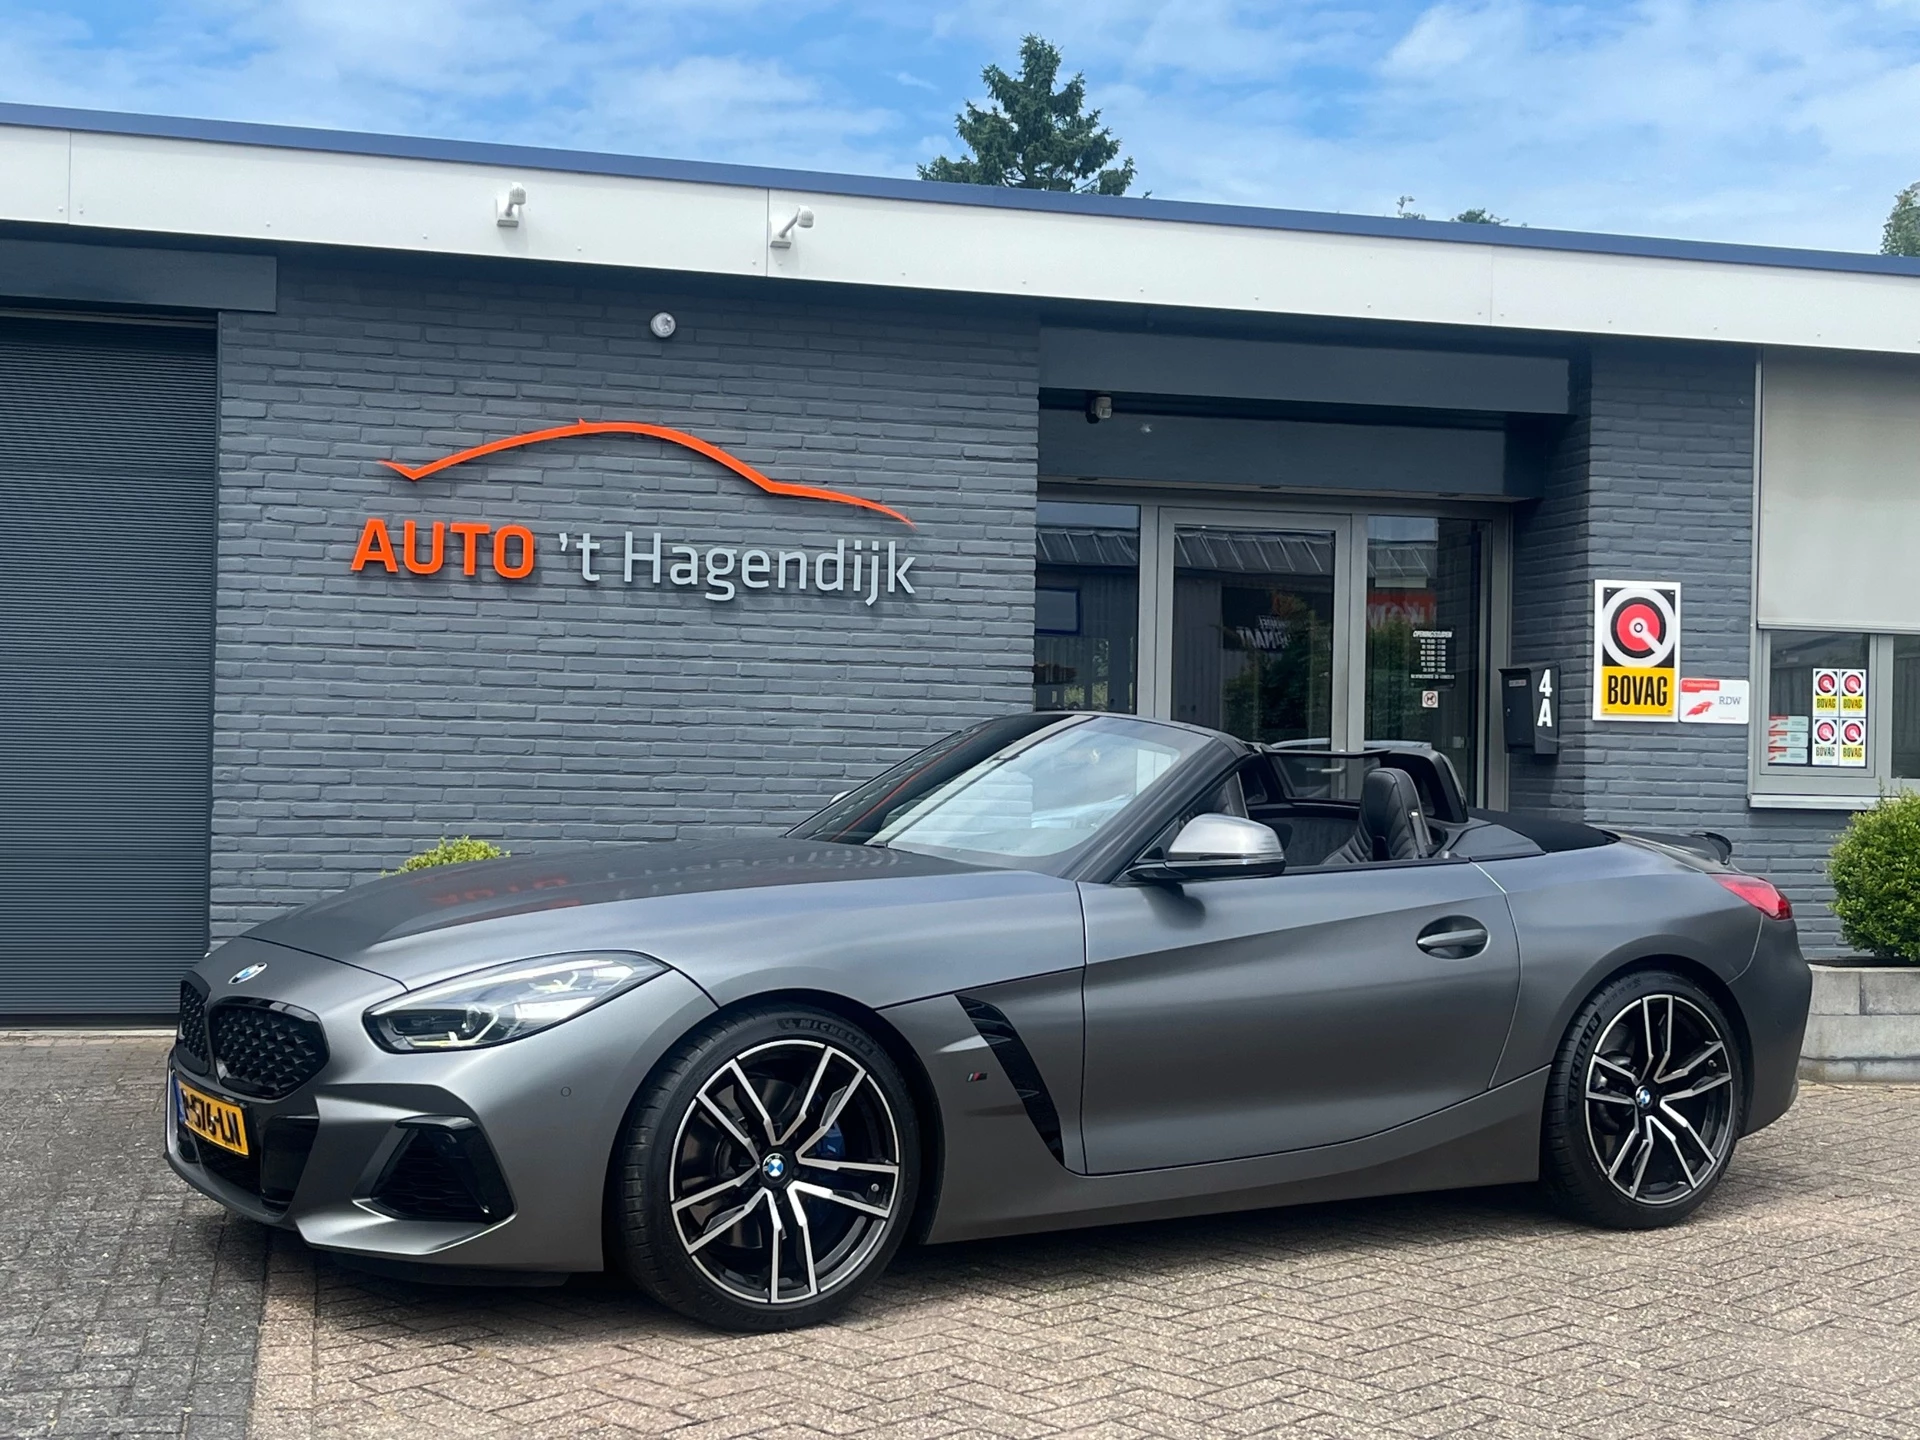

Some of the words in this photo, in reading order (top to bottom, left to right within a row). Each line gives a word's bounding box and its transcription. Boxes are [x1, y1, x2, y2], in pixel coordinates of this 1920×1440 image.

[351, 518, 535, 579] AUTO
[623, 531, 916, 607] Hagendijk
[1538, 668, 1553, 697] 4
[1608, 674, 1668, 707] BOVAG
[1718, 695, 1742, 706] RDW
[1816, 698, 1837, 709] BOVAG
[1843, 699, 1863, 709] BOVAG
[1536, 698, 1553, 727] A
[1815, 746, 1836, 757] BOVAG
[1842, 747, 1863, 758] BOVAG
